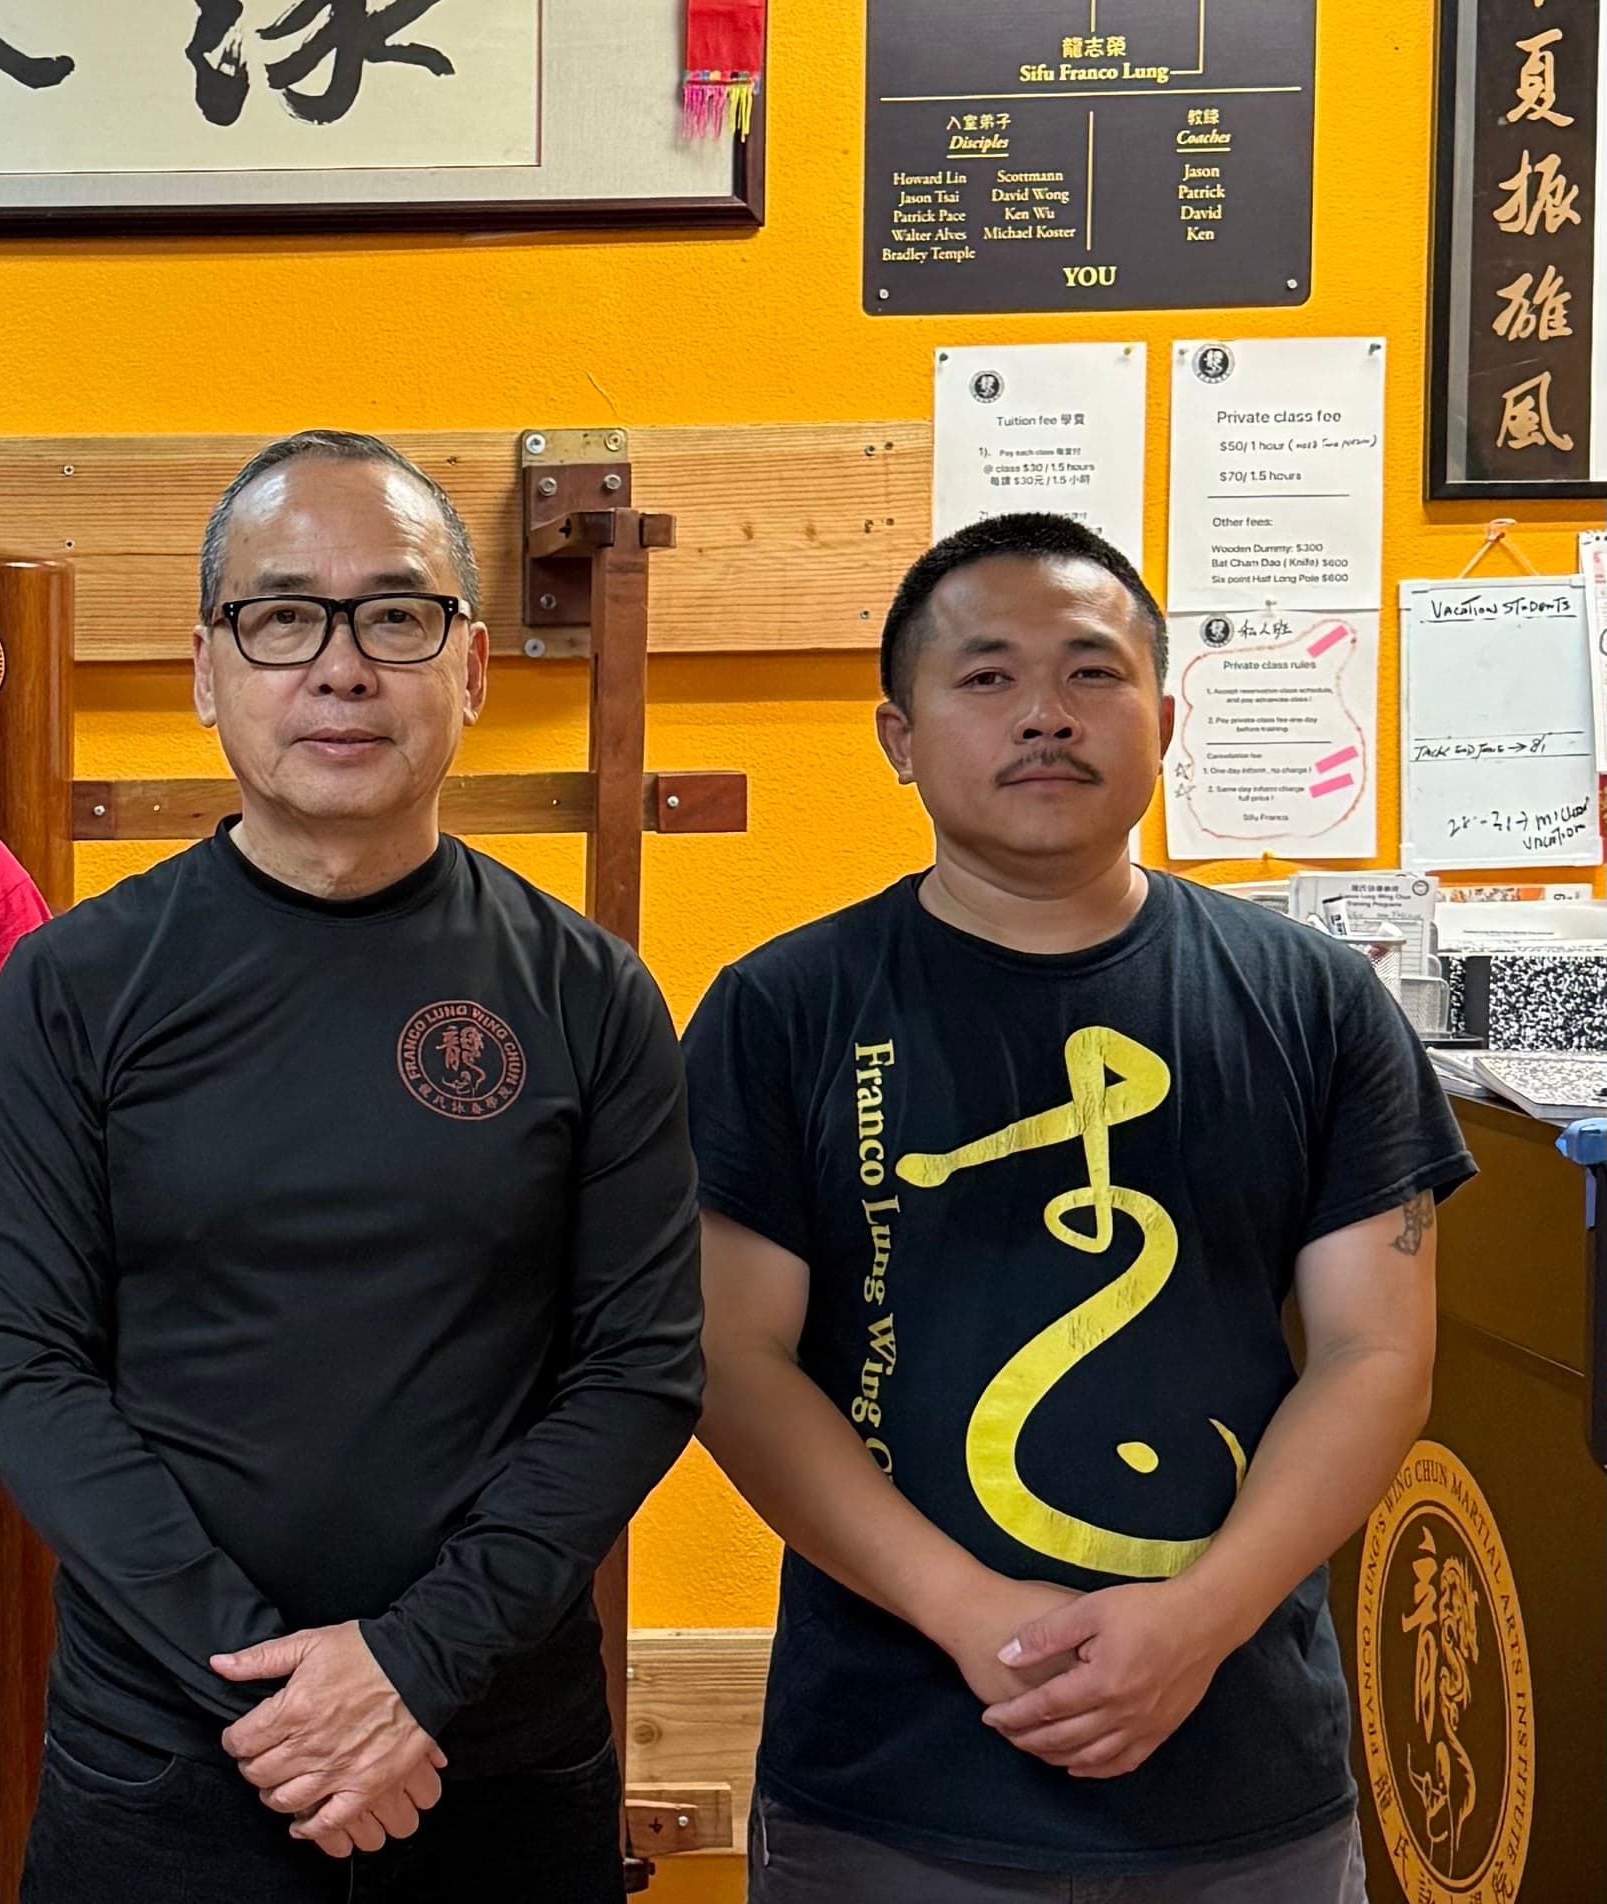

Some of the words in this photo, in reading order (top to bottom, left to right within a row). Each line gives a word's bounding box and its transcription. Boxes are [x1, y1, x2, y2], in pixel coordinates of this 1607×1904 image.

[1062, 36, 1127, 58] 龍志榮
[1019, 64, 1055, 82] Sifu
[1059, 63, 1118, 81] Franco
[1122, 62, 1169, 83] Lung
[946, 113, 1011, 130] 入室弟子
[949, 134, 1009, 153] Disciples
[1176, 129, 1232, 144] Coaches
[893, 171, 943, 185] Howard
[946, 171, 967, 184] Lin
[997, 170, 1064, 183] Scottmann
[1182, 164, 1220, 181] Jason
[898, 191, 932, 206] Jason
[934, 190, 959, 203] Tsai
[991, 188, 1029, 202] David
[1032, 187, 1070, 204] Wong
[1178, 184, 1226, 200] Patrick
[893, 210, 936, 223] Patrick
[938, 210, 966, 222] Pace
[1004, 207, 1029, 220] Ken
[1032, 207, 1055, 219] Wu
[1180, 204, 1222, 220] David
[891, 229, 932, 242] Walter
[935, 227, 967, 240] Alves
[983, 226, 1032, 240] Michael
[1036, 225, 1076, 238] Koster
[1186, 227, 1215, 241] Ken
[882, 247, 928, 263] Bradley
[931, 246, 976, 263] Temple
[1063, 266, 1117, 287] YOU
[996, 416, 1036, 426] Tuition
[1039, 415, 1058, 425] fee
[1217, 411, 1270, 424] Private
[1274, 410, 1313, 423] class
[1317, 409, 1342, 422] fee
[1220, 440, 1247, 453] $50/
[1259, 440, 1284, 450] hour
[995, 464, 1020, 473] class
[1022, 463, 1043, 472] $30
[1051, 462, 1065, 472] 1.5
[1067, 463, 1095, 471] hours
[1053, 476, 1067, 484] 1.5
[1220, 471, 1247, 483] $70/
[1251, 470, 1267, 481] 1.5
[1269, 471, 1302, 481] hours
[1212, 517, 1244, 527] Other
[1246, 517, 1273, 527] fees:
[1211, 545, 1252, 553] Wooden
[1253, 544, 1293, 554] Dummy:
[1296, 543, 1323, 552] $300
[1211, 558, 1228, 567] Bat
[1261, 558, 1281, 567] Dao
[1227, 575, 1251, 584] point
[1273, 575, 1297, 584] Long
[1299, 574, 1319, 582] Pole
[1223, 660, 1260, 670] Private
[1261, 660, 1289, 670] class
[1291, 660, 1316, 670] rules
[404, 1021, 427, 1080] FRANCO
[426, 1005, 467, 1023] LUNG
[471, 1007, 508, 1040] WING
[504, 1042, 522, 1085] CHUN
[854, 1038, 895, 1187] Franco
[861, 1194, 901, 1306] Lung
[851, 1312, 896, 1428] Wing
[1414, 1459, 1448, 1488] CHUN
[1384, 1467, 1413, 1514] WING
[1450, 1472, 1502, 1584] MARTIAL
[1500, 1595, 1523, 1675] ARTS
[1507, 1692, 1528, 1865] INSTITUTE
